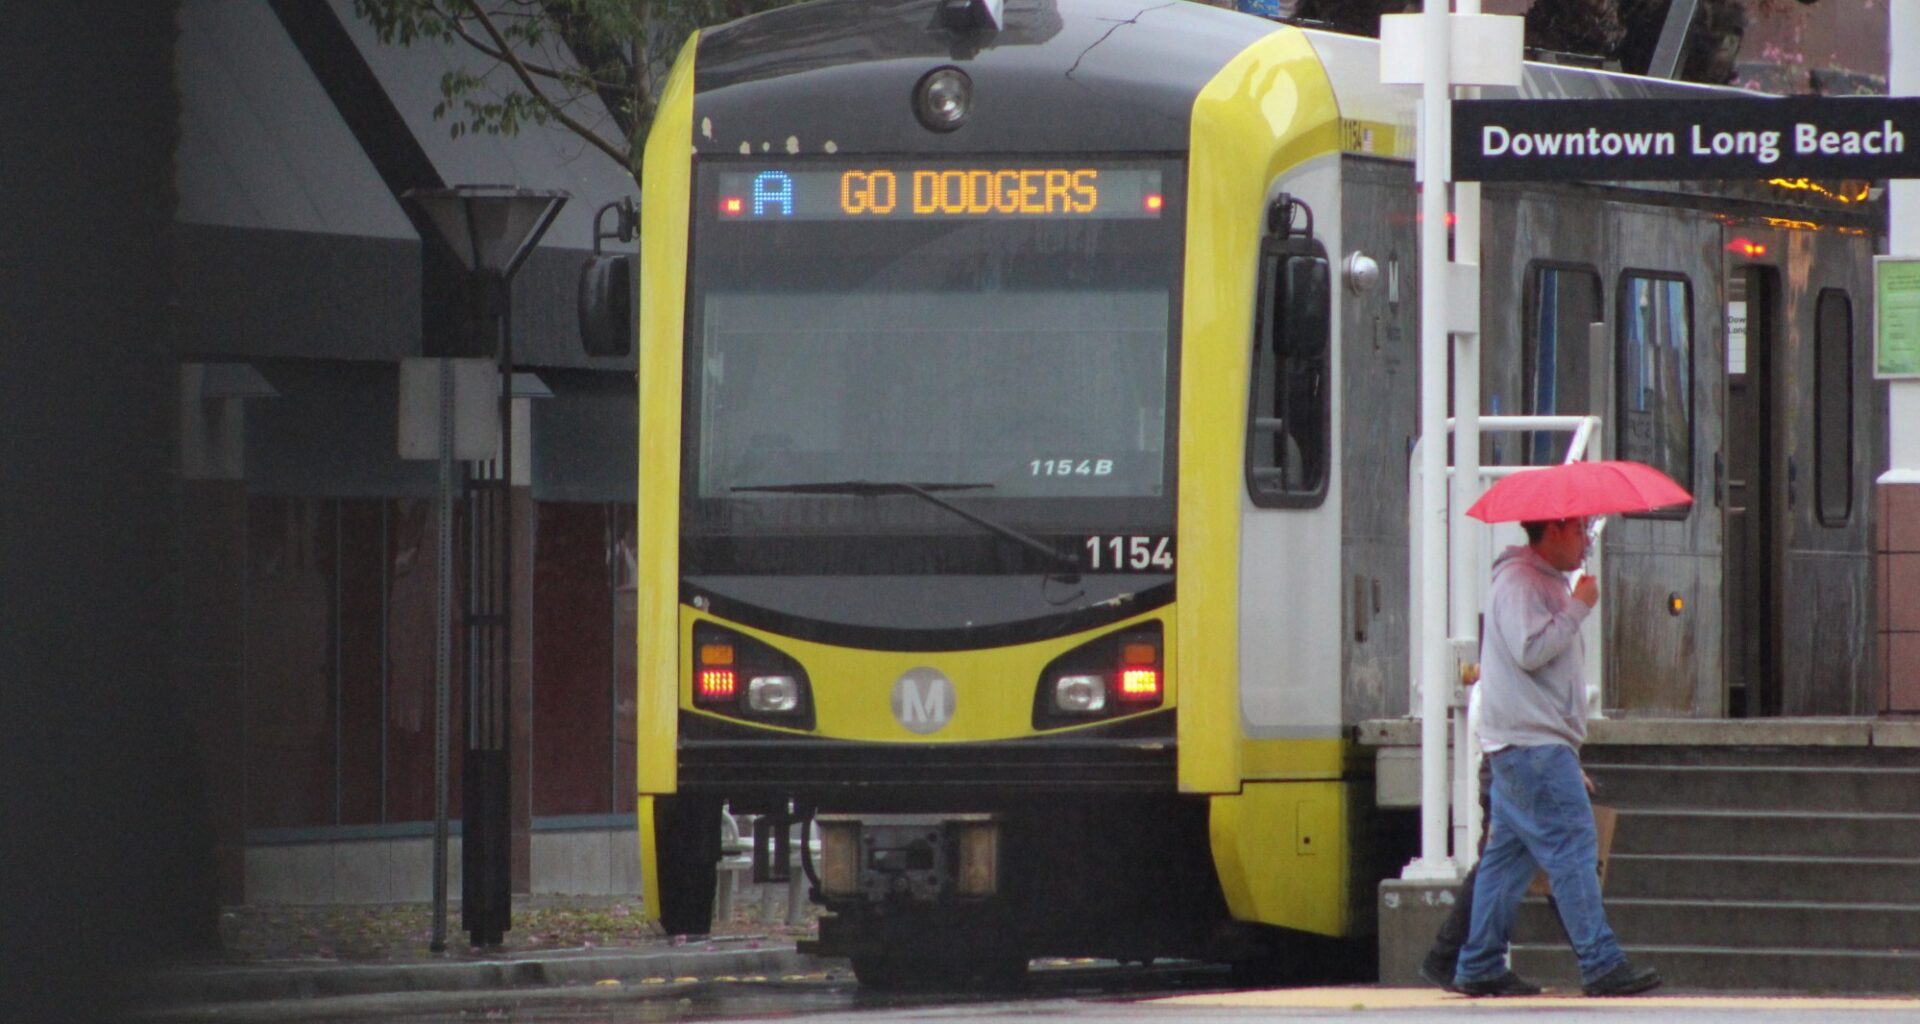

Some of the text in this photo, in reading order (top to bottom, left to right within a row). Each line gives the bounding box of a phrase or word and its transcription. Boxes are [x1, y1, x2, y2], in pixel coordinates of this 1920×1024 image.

[1482, 120, 1904, 163] Downtown Long Beach
[753, 168, 1098, 215] A GO DODGERS
[1030, 459, 1113, 476] 1154B
[1086, 536, 1174, 570] 1154
[902, 679, 945, 722] M
